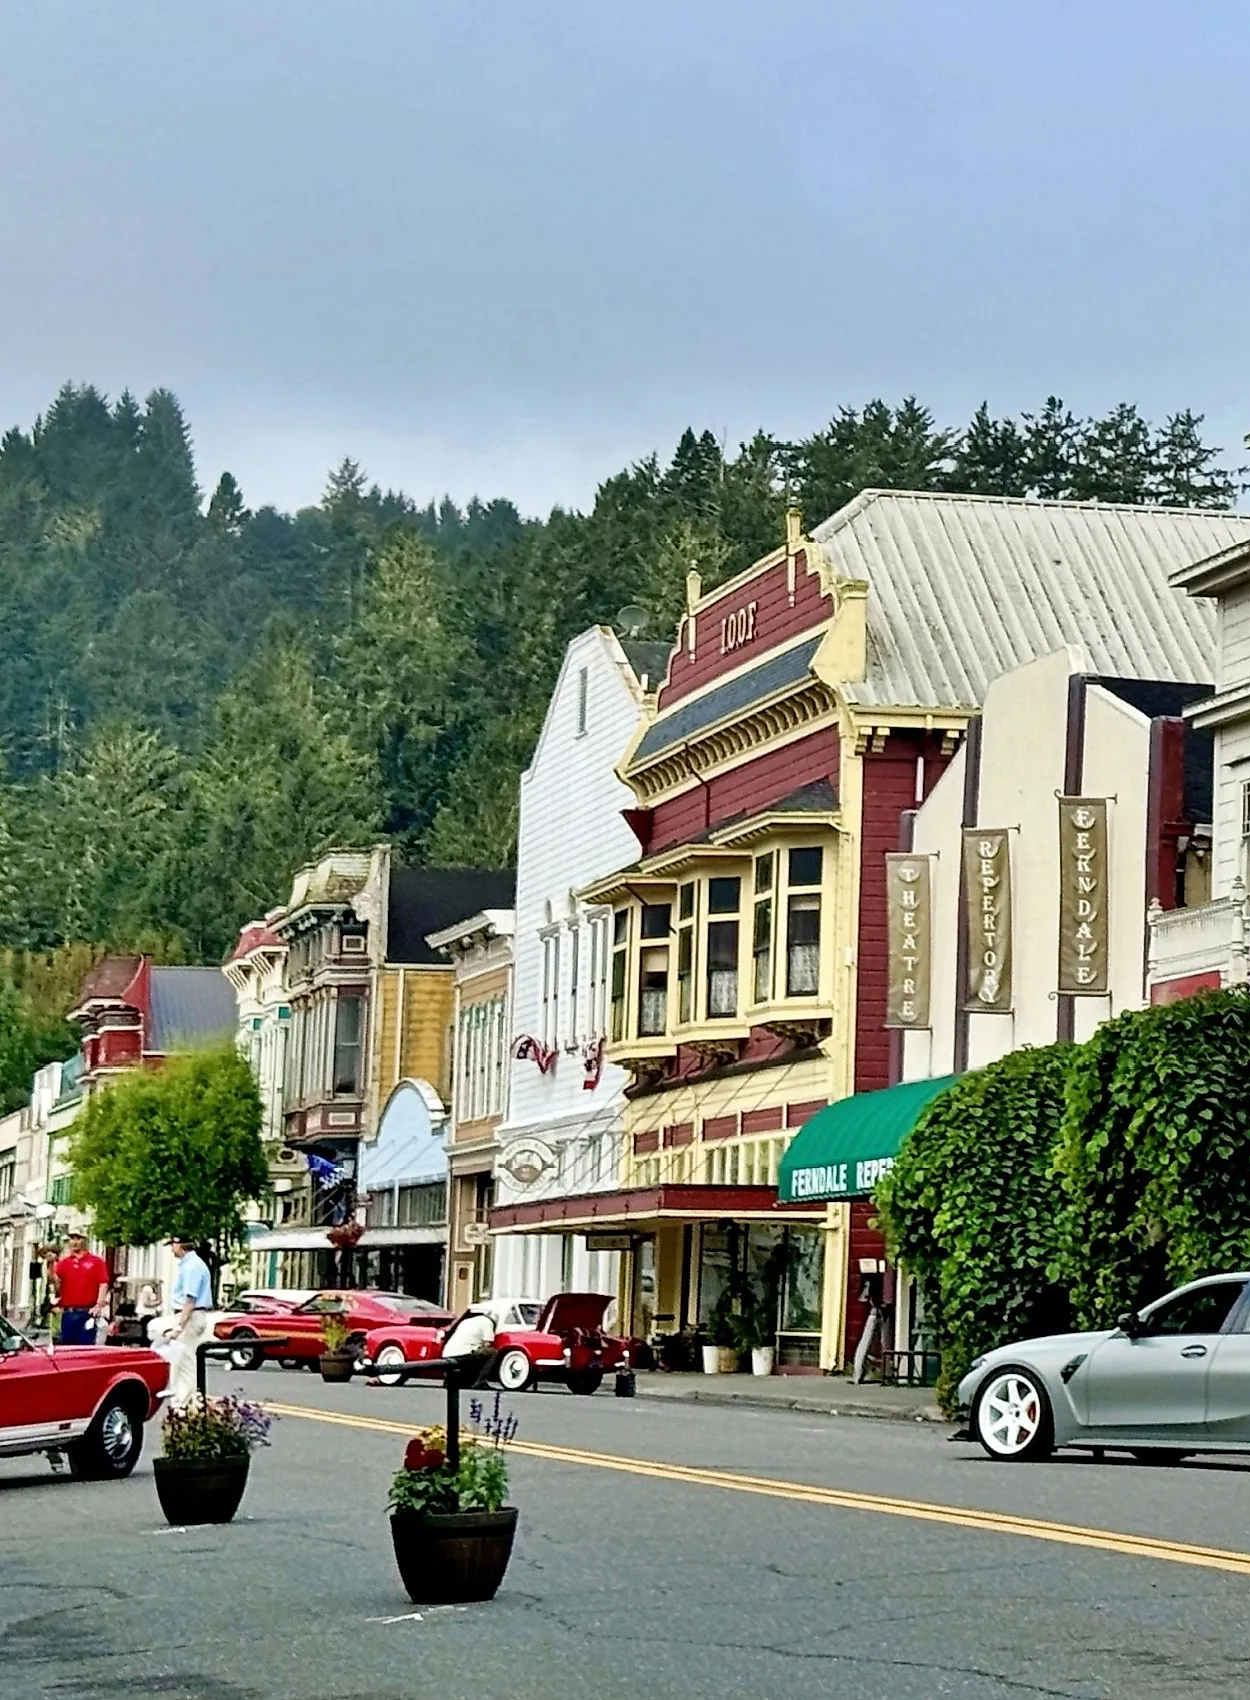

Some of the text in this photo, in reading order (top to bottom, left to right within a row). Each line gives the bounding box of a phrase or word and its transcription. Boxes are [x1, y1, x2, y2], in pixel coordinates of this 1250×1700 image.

[899, 868, 920, 1022] THEATRE
[978, 841, 1000, 1004] REPERTORY
[1071, 809, 1098, 985] FERNDALE
[791, 1163, 847, 1197] FERNDALE
